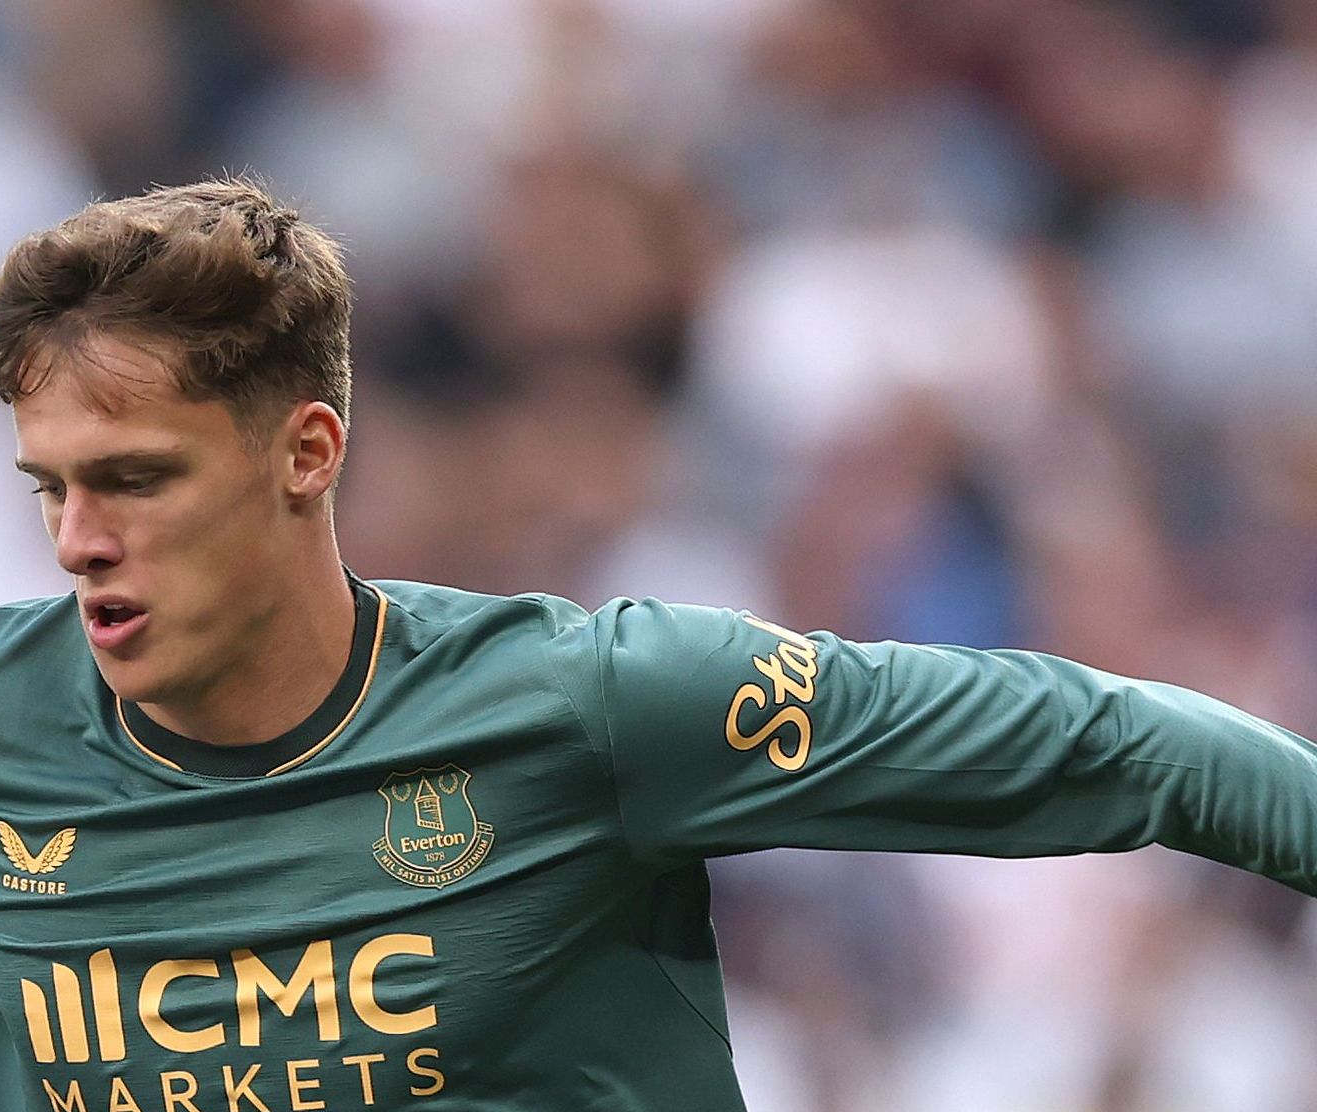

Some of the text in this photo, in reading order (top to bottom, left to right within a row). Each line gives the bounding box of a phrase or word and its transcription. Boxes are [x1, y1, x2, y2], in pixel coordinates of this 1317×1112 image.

[400, 832, 465, 853] Everton
[380, 839, 489, 884] NIL SATIS NISI OPTIMUM
[425, 851, 446, 863] 1878
[2, 873, 66, 895] CASTORE
[138, 933, 438, 1054] CMC
